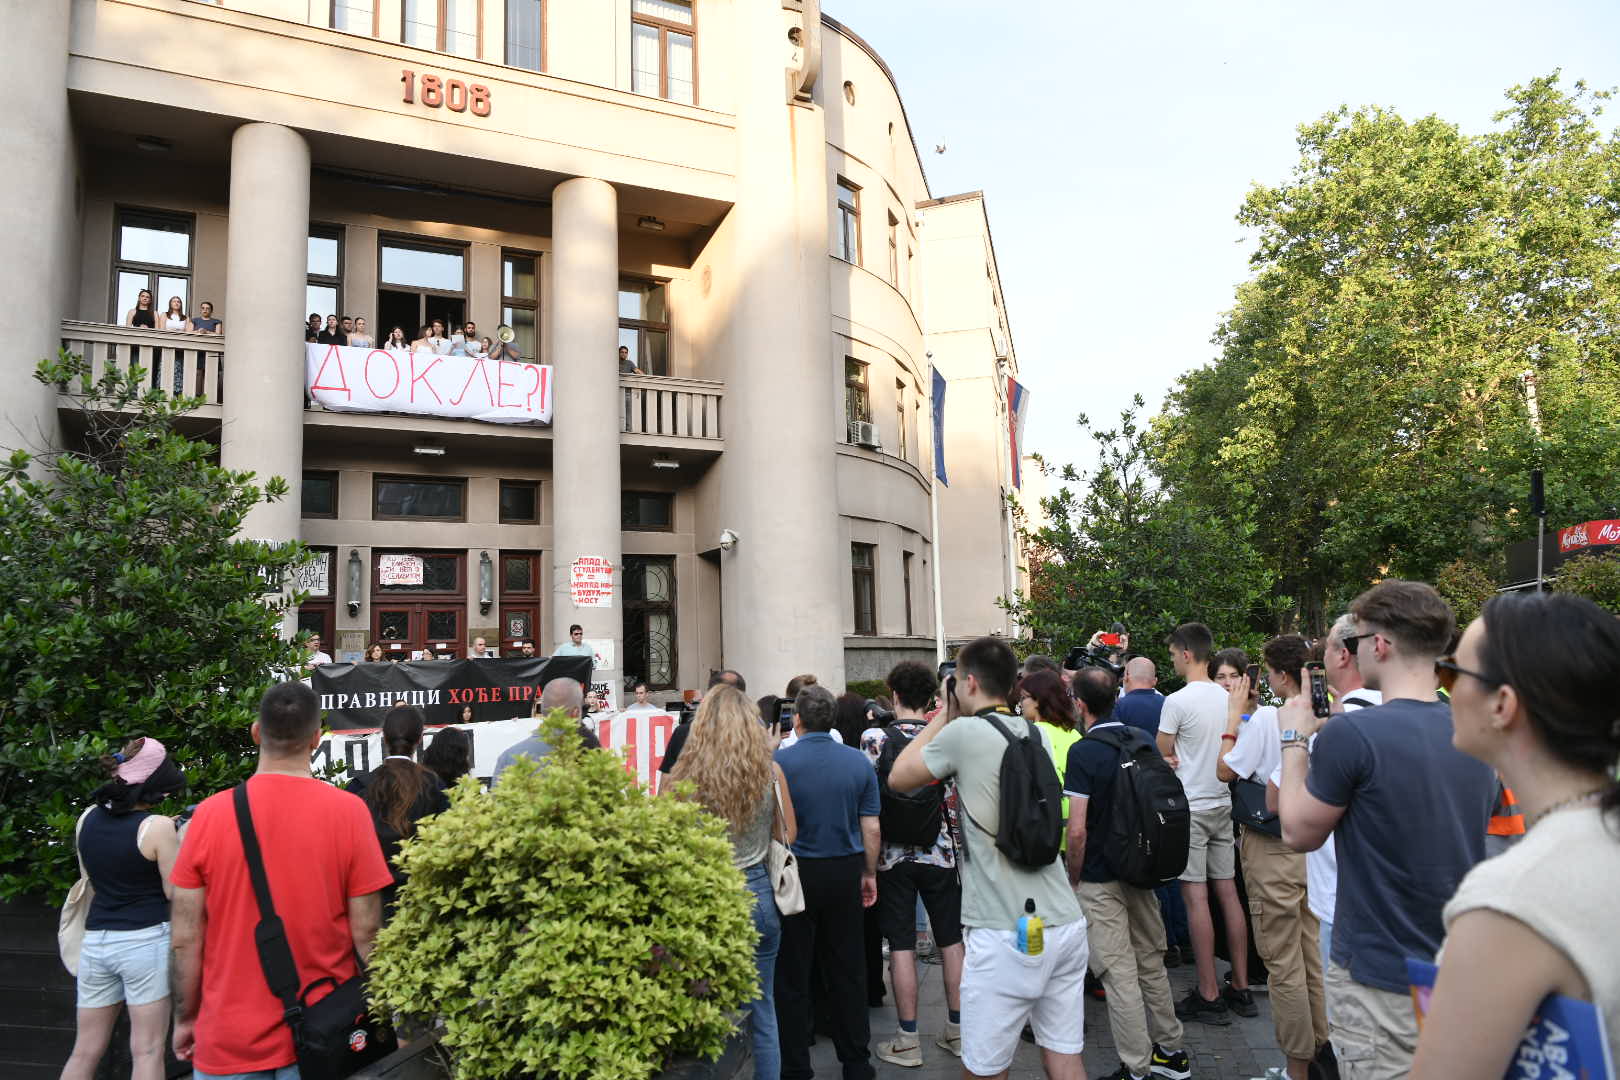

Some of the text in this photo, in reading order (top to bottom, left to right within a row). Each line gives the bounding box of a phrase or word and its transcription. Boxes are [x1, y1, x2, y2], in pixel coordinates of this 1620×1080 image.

[401, 69, 491, 117] 1808
[310, 344, 547, 414] ДОКЛЕ?!
[320, 689, 441, 710] ПРАВНИЦИ
[447, 687, 502, 704] ХОЋЕ
